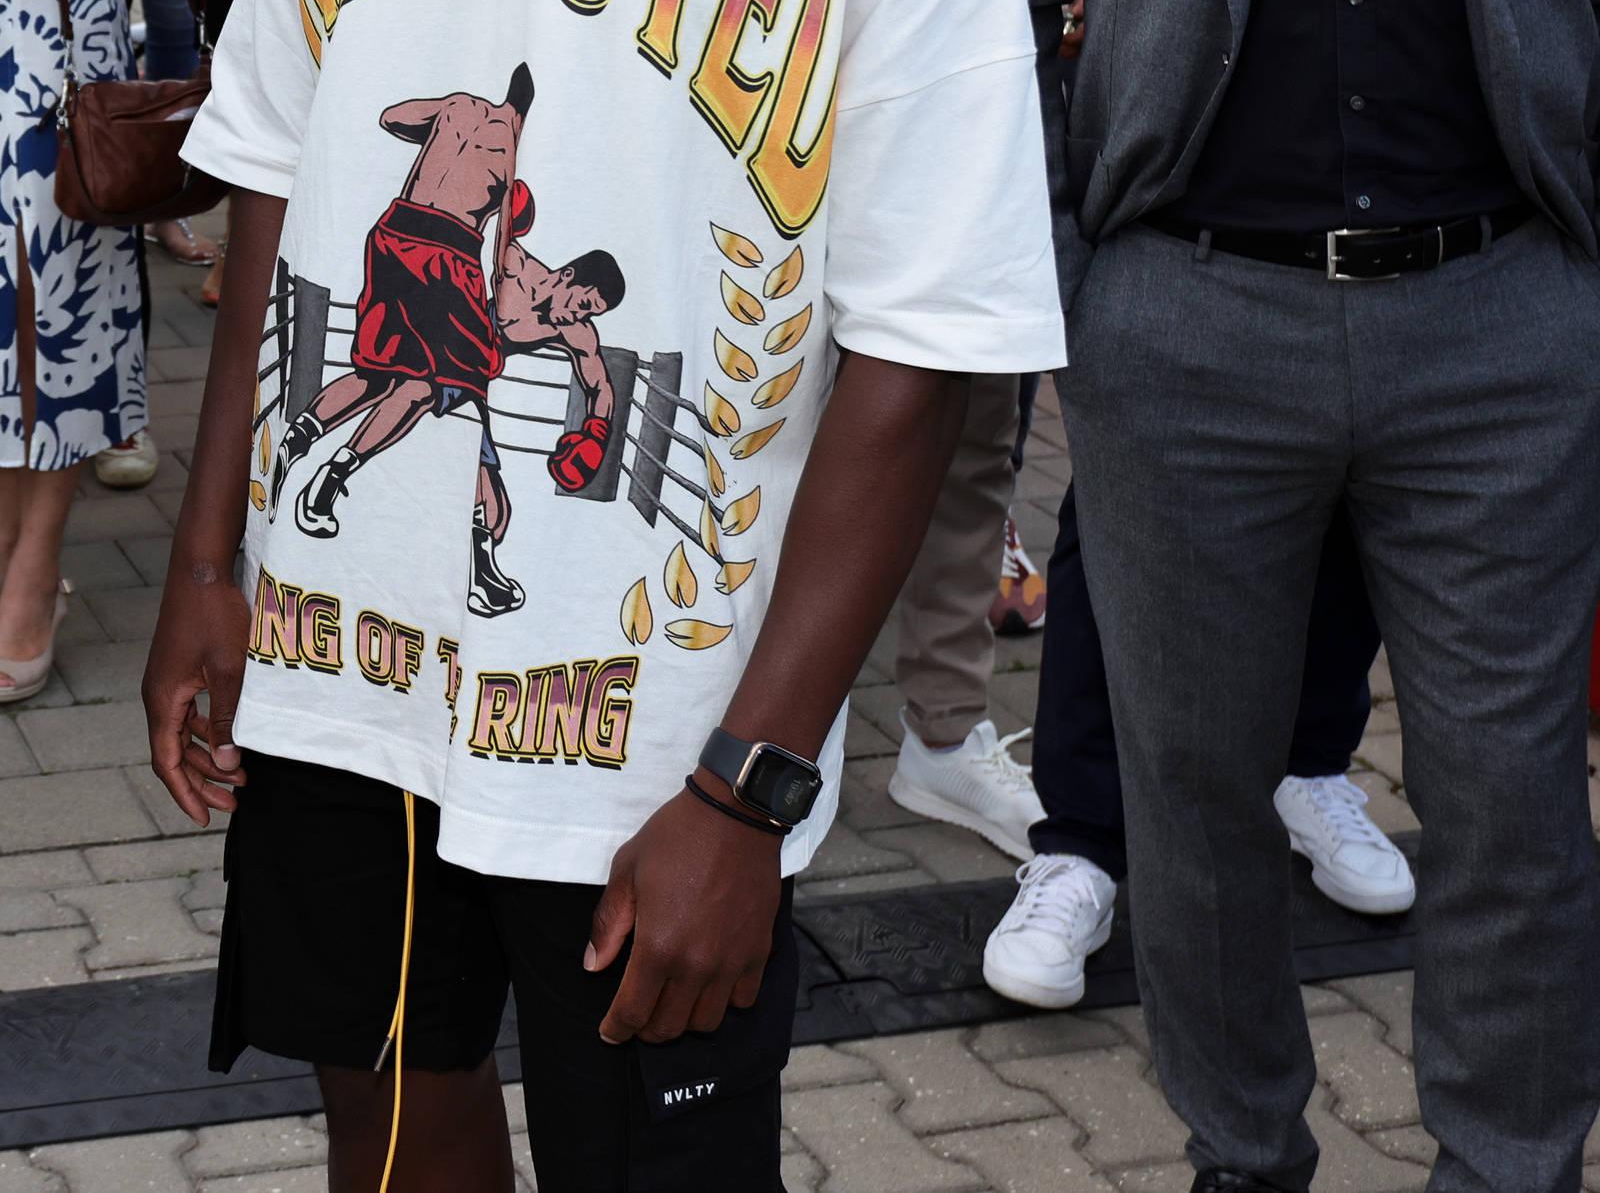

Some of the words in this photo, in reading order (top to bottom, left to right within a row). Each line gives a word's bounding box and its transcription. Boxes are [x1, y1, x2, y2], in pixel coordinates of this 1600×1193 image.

[247, 562, 343, 677] ING
[357, 610, 424, 695] OF
[468, 656, 640, 771] RING
[663, 1082, 715, 1105] NVLTY
